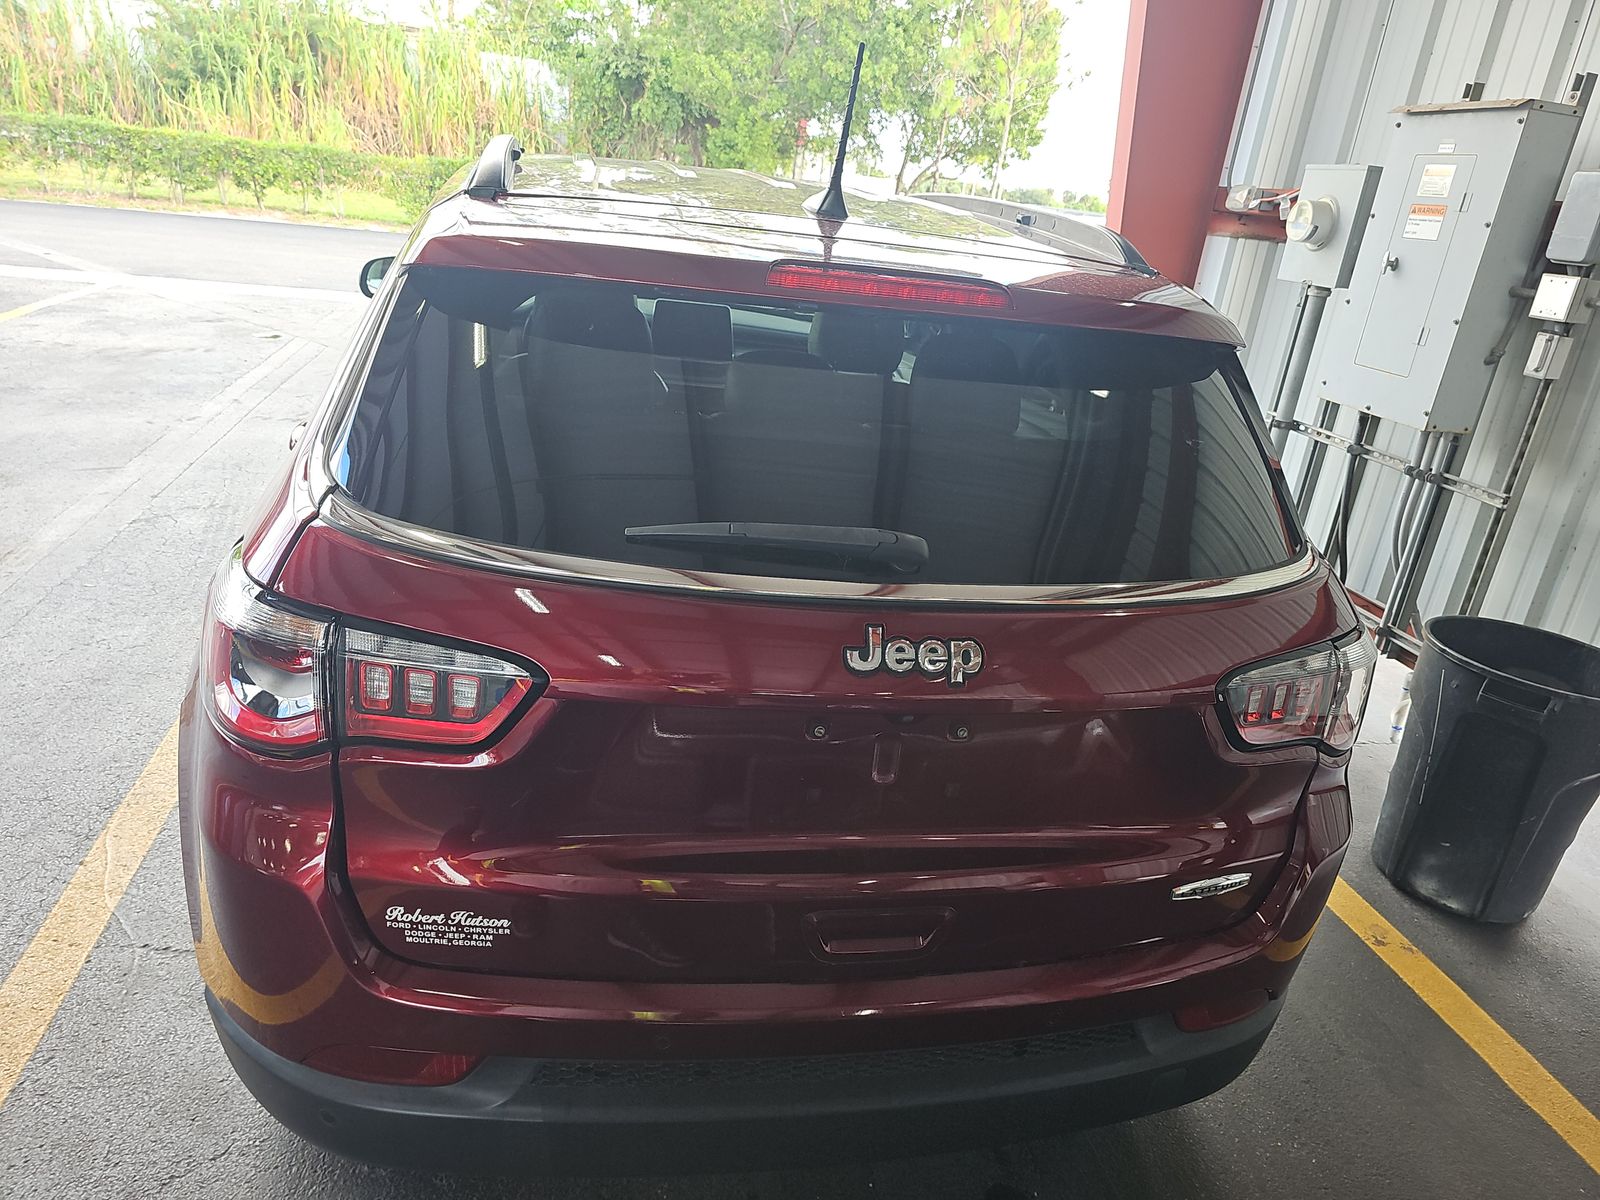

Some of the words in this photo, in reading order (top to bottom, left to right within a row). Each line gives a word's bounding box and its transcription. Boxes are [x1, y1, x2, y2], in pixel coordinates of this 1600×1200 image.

[1416, 206, 1446, 216] WARNING
[846, 626, 983, 684] Jeep
[385, 905, 446, 924] Robert
[448, 910, 512, 928] Hutson
[386, 921, 411, 929] FORD
[418, 923, 457, 932] LINCOLN
[463, 926, 511, 935] CHRYSLER
[404, 930, 436, 938] DODGE
[443, 932, 466, 940] JEEP
[452, 939, 492, 947] GEORGIA
